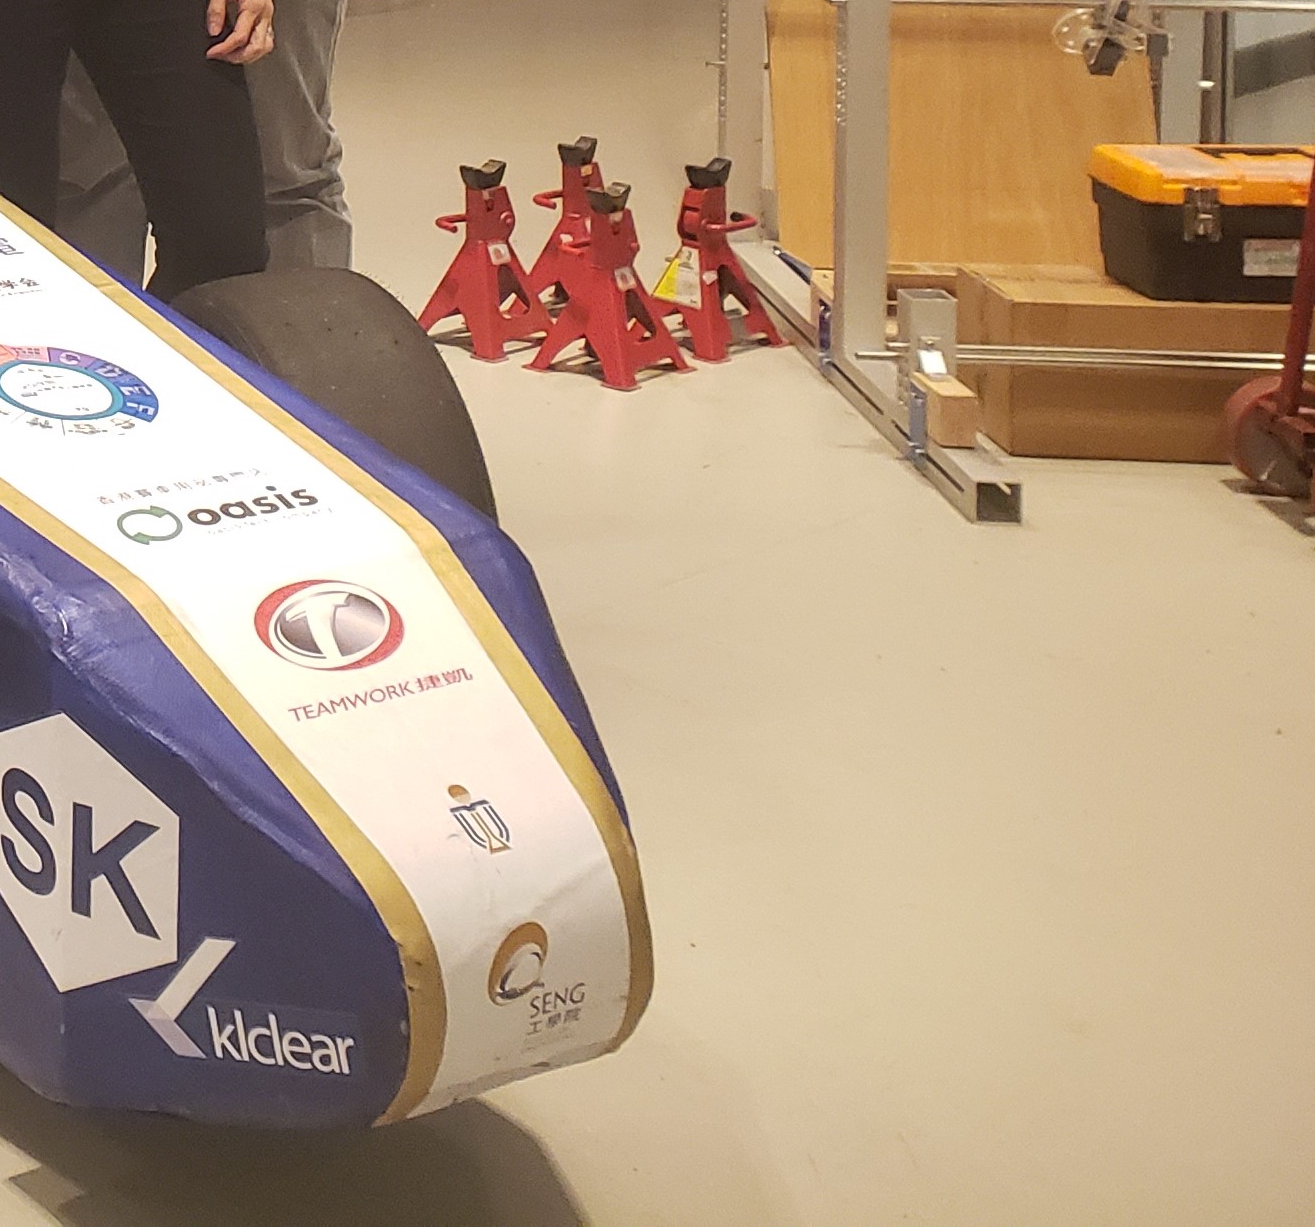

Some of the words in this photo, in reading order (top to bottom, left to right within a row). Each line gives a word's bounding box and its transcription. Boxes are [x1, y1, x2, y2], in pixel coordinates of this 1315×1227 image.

[187, 485, 318, 526] oasis
[288, 681, 416, 722] TEAMWORK
[0, 767, 162, 941] SK
[530, 982, 585, 1019] SENG
[207, 1005, 355, 1075] klclear
